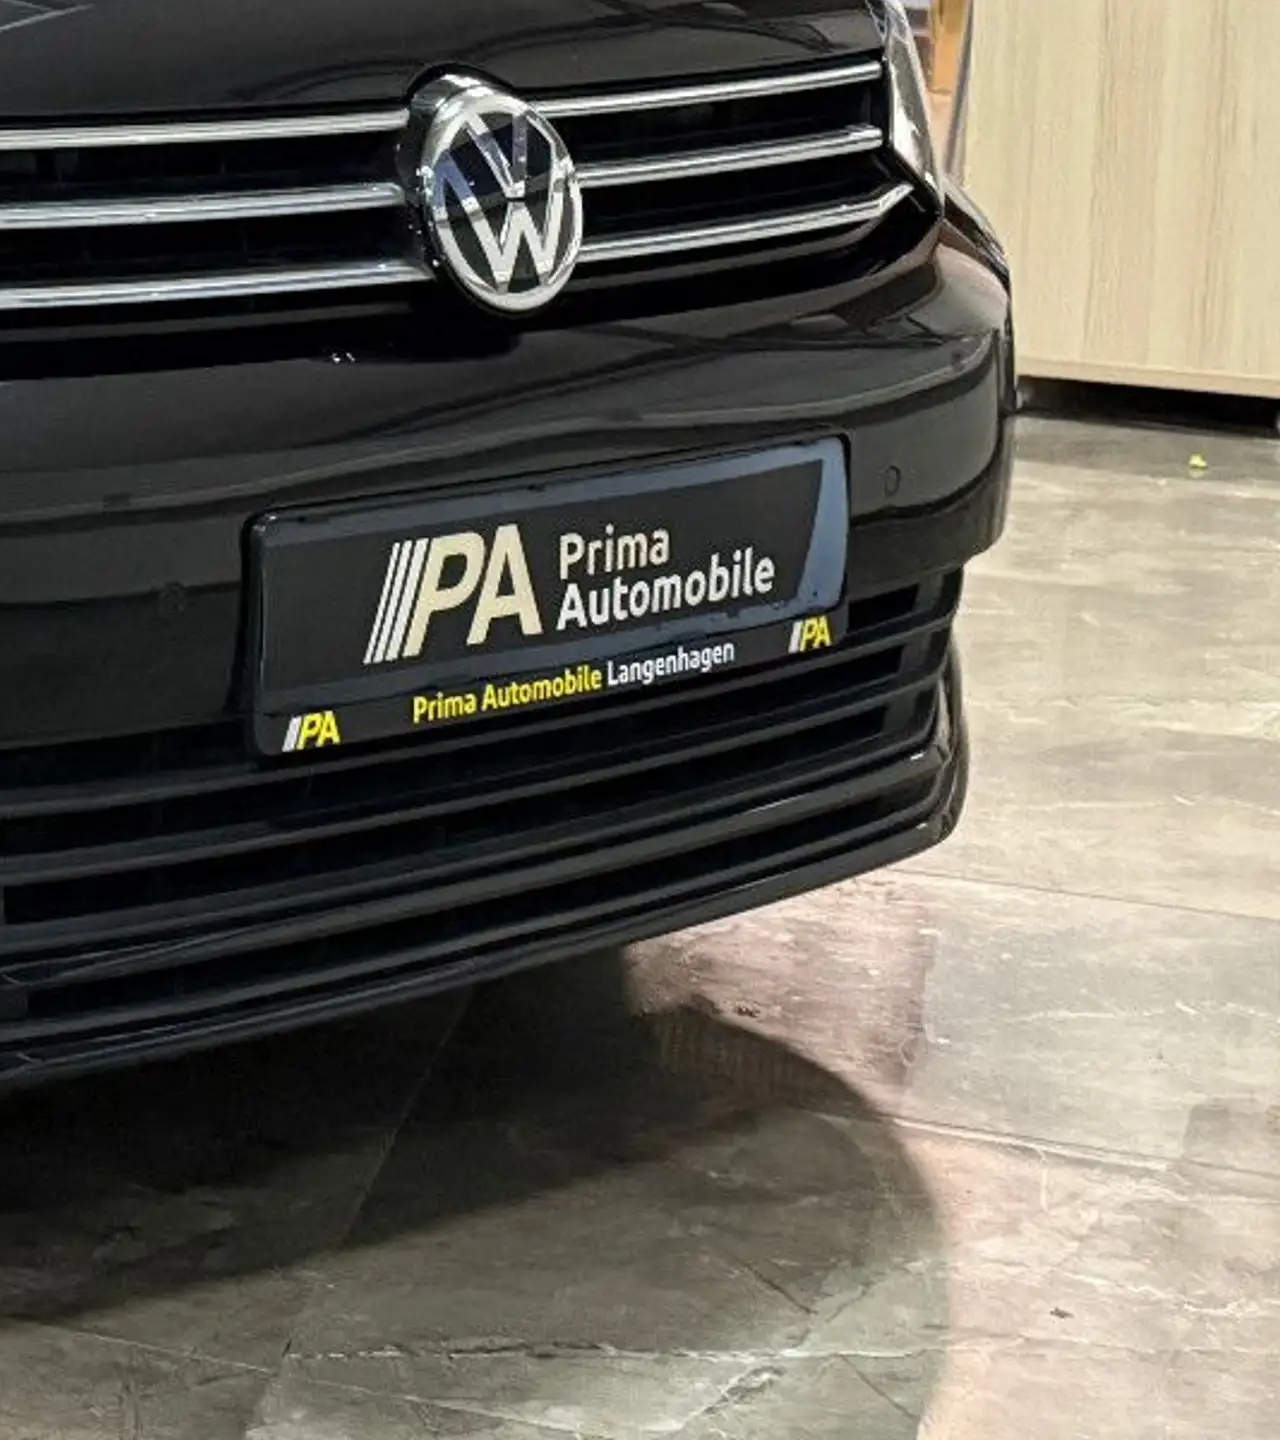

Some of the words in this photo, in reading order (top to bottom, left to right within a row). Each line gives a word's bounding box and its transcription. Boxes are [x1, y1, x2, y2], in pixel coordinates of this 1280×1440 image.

[556, 546, 777, 632] Automobile
[559, 524, 671, 581] Prima
[411, 691, 478, 724] Prima
[481, 665, 603, 713] Automobile
[606, 640, 736, 687] Langenhagen
